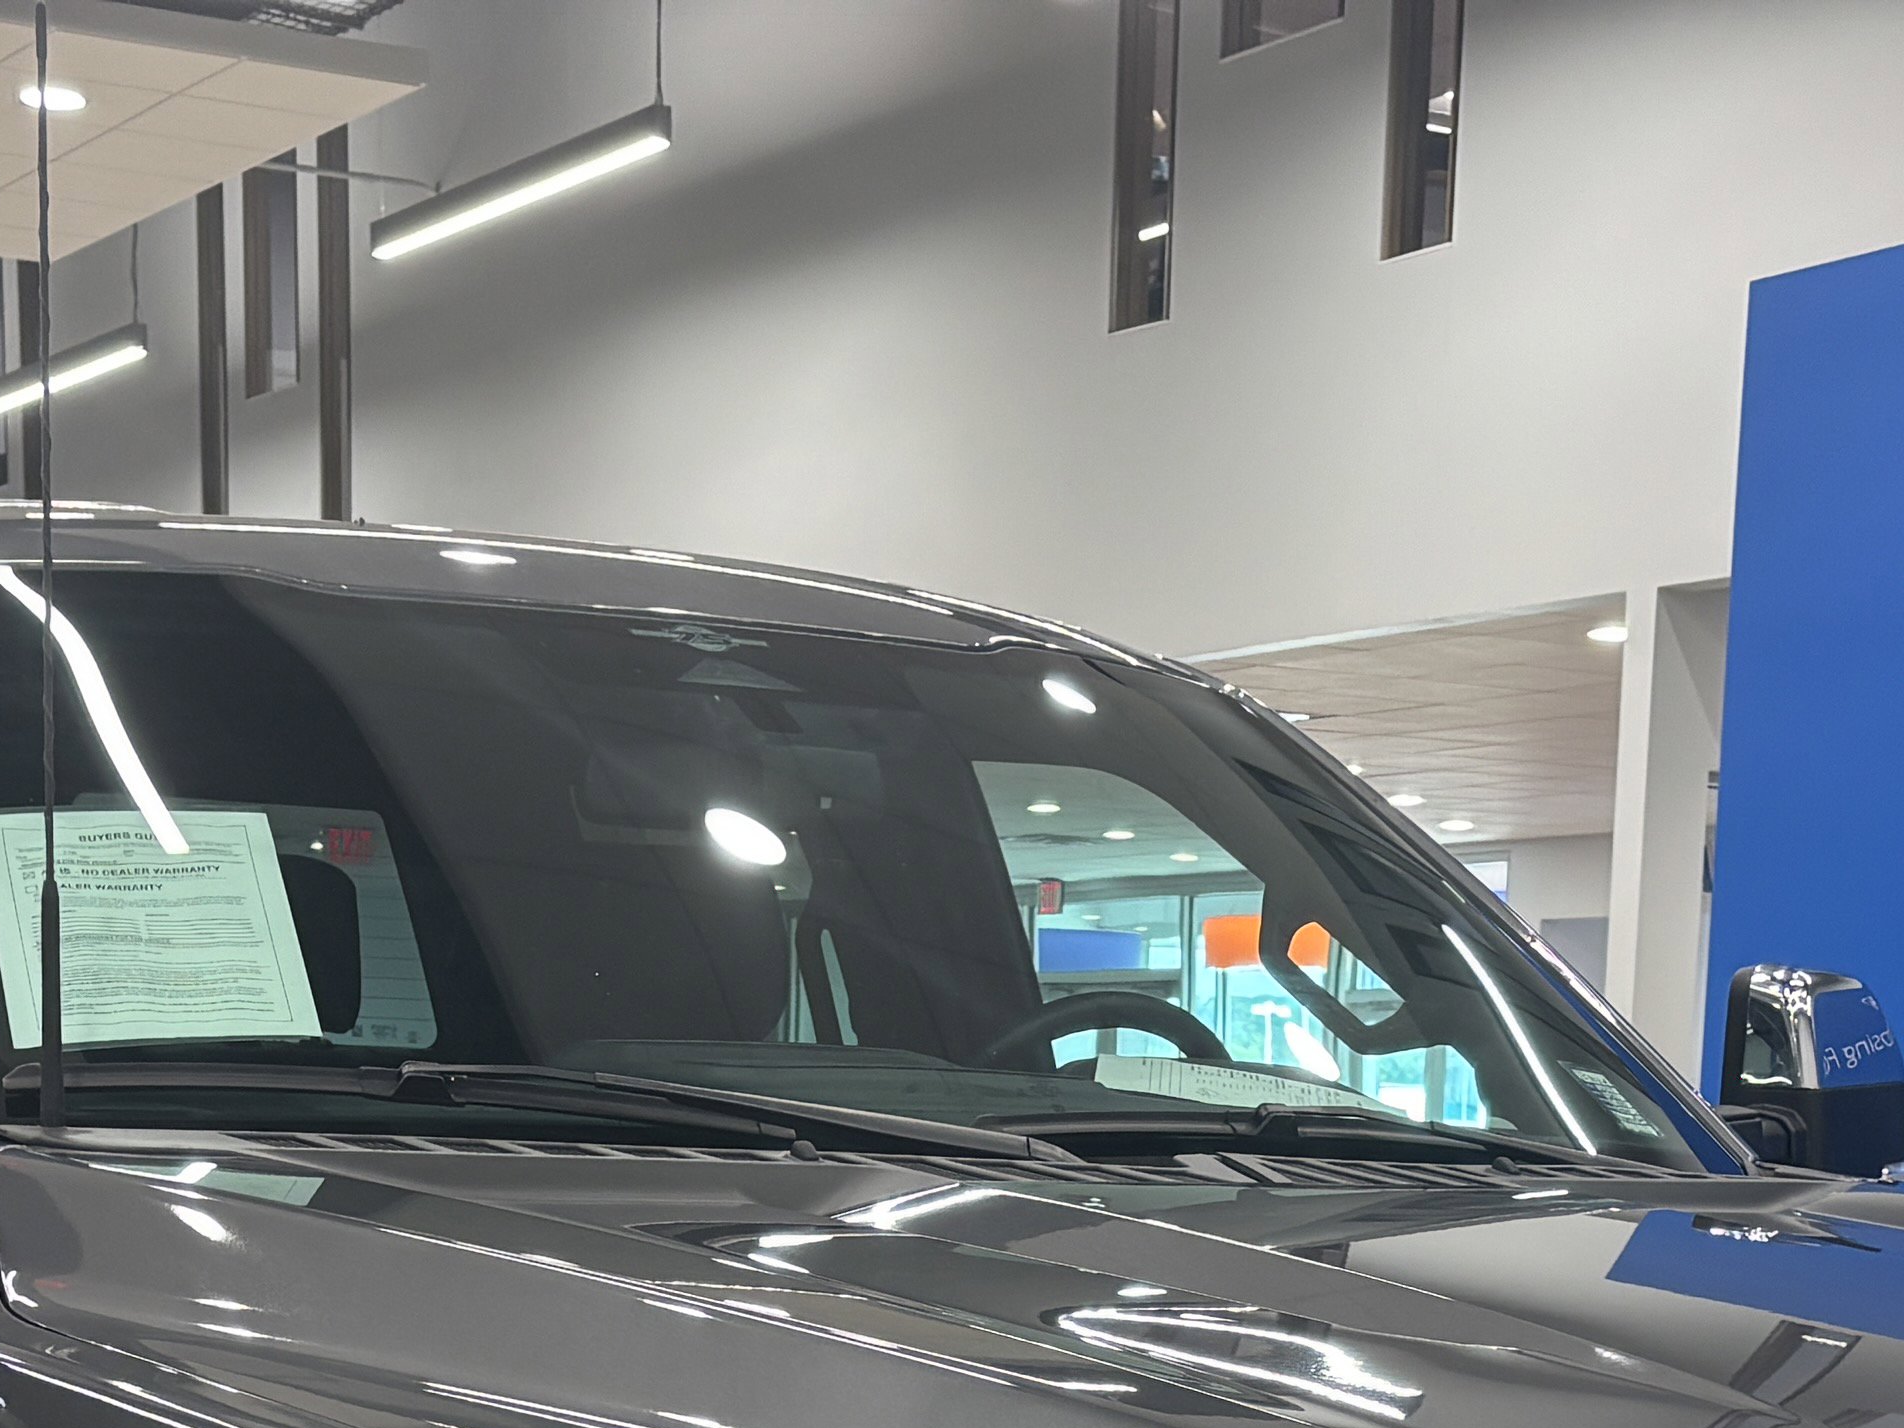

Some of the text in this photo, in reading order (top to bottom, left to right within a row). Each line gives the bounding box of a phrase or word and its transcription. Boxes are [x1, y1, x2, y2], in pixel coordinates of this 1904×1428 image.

[78, 831, 131, 843] BUYERS
[81, 868, 99, 876] NO
[102, 867, 150, 877] DEALER
[153, 864, 222, 875] WARRANTY
[95, 883, 164, 892] WARRANTY
